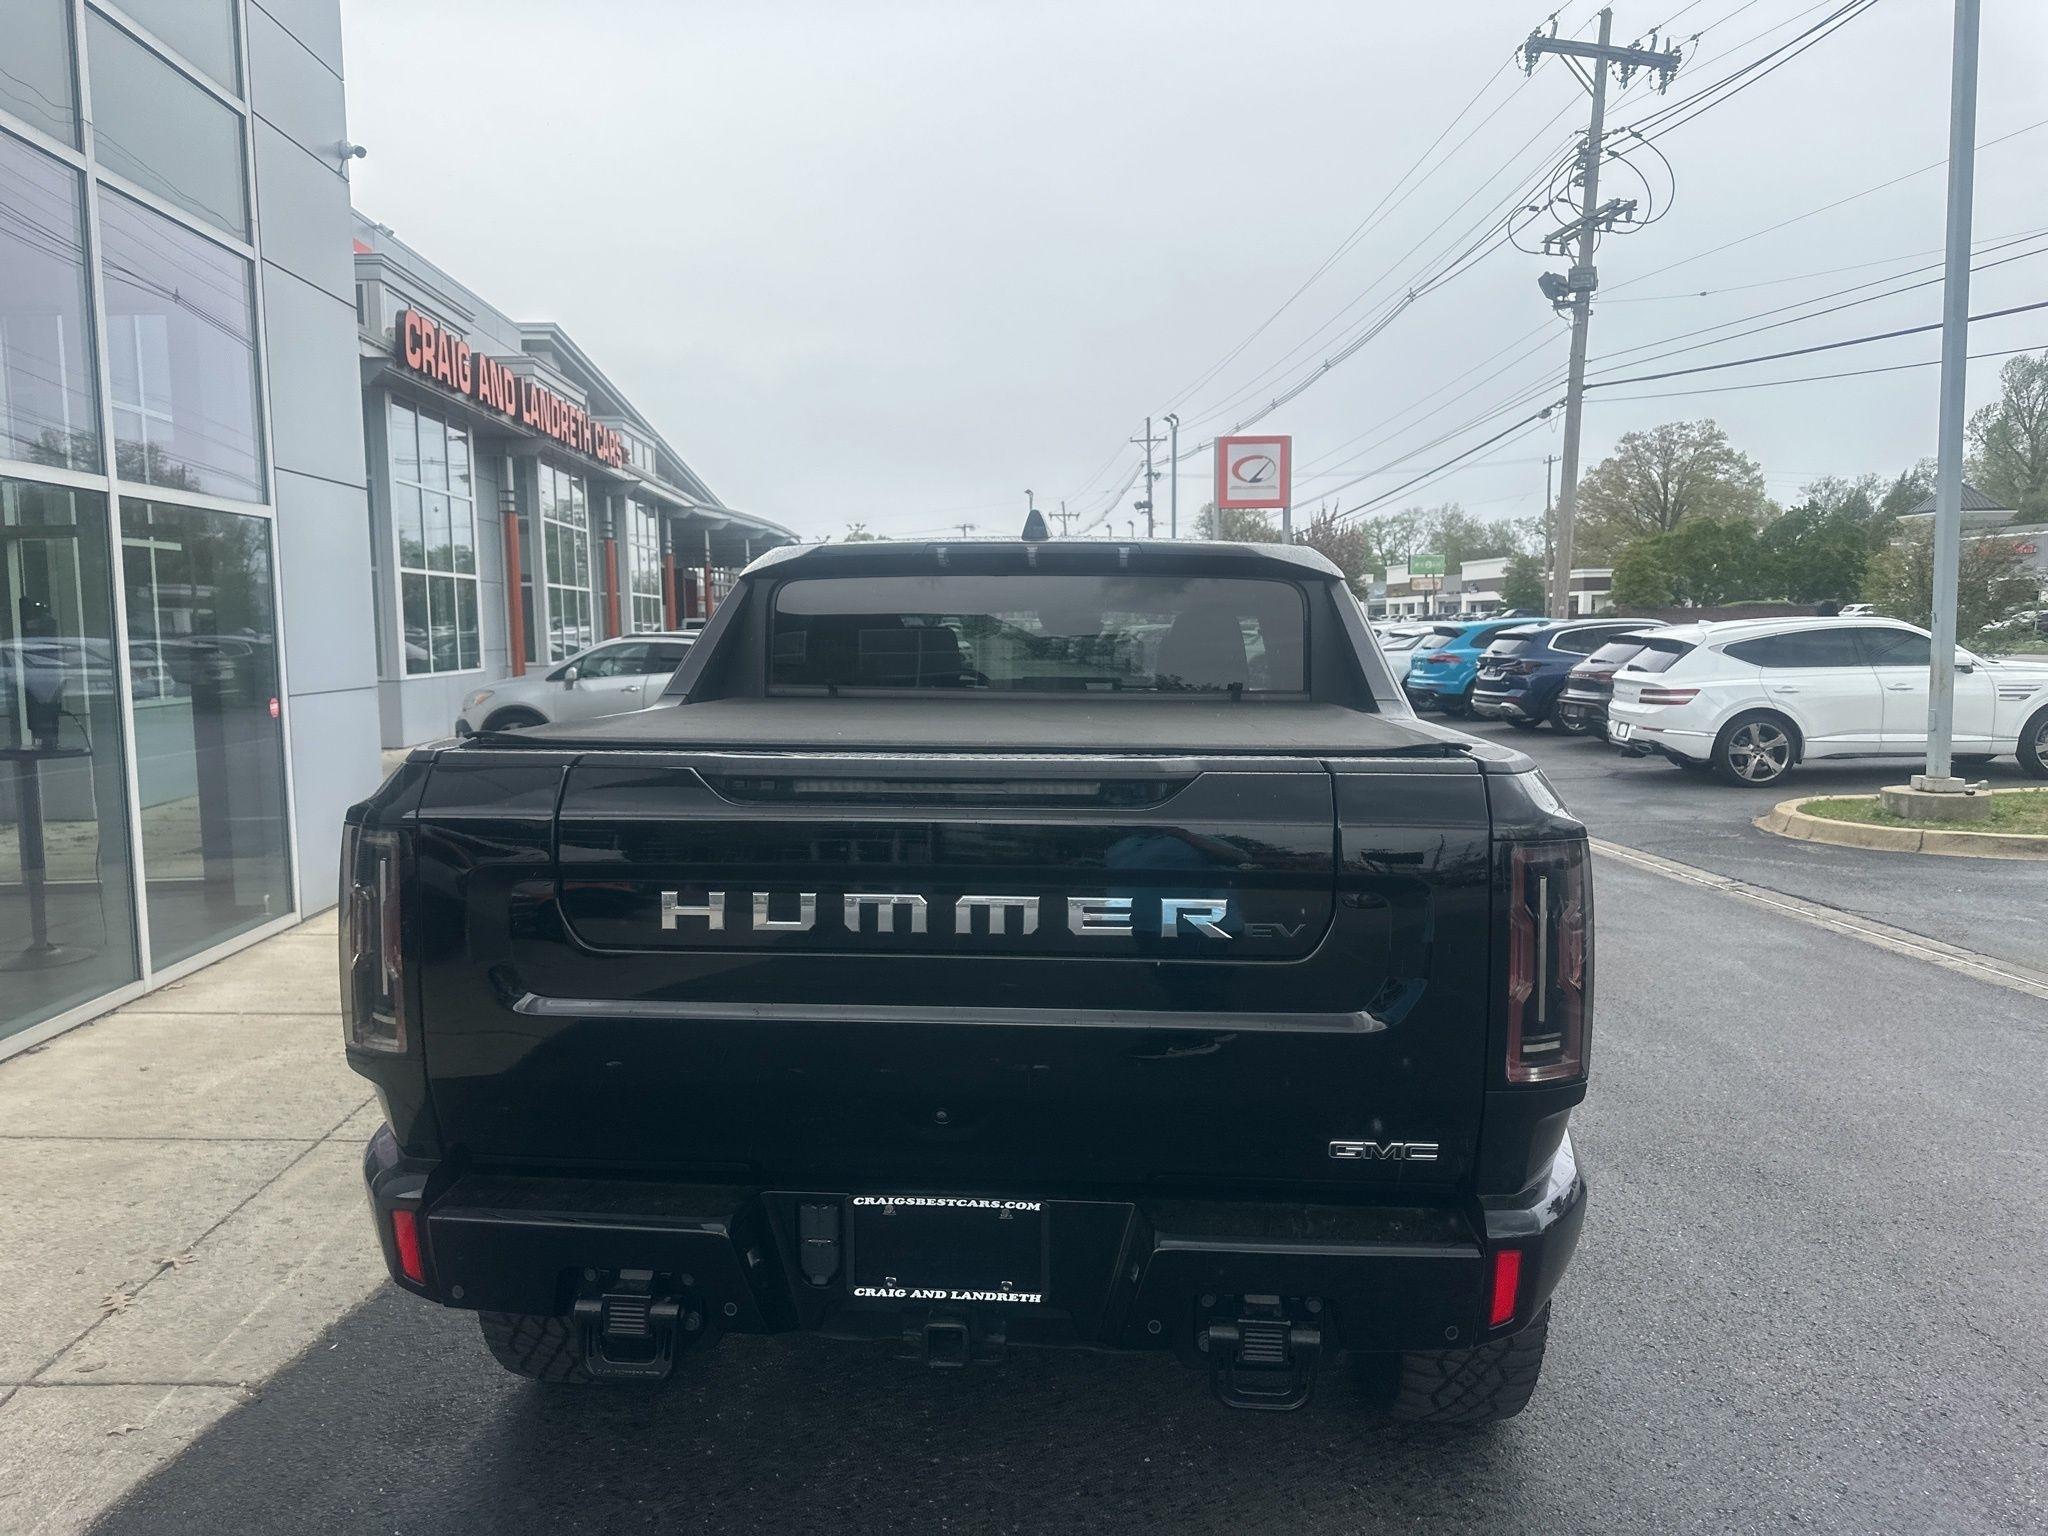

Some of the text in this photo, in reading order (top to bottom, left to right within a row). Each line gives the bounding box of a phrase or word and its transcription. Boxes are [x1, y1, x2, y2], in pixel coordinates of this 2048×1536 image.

[404, 309, 623, 469] CRAIG AND LANDRETH CARS
[661, 891, 1307, 939] HUMMER EV
[1328, 1140, 1439, 1161] GMC
[853, 1197, 1041, 1211] CRAIGSBESTCARS.COM
[853, 1287, 1042, 1303] CRAIG AND LANDRETH
